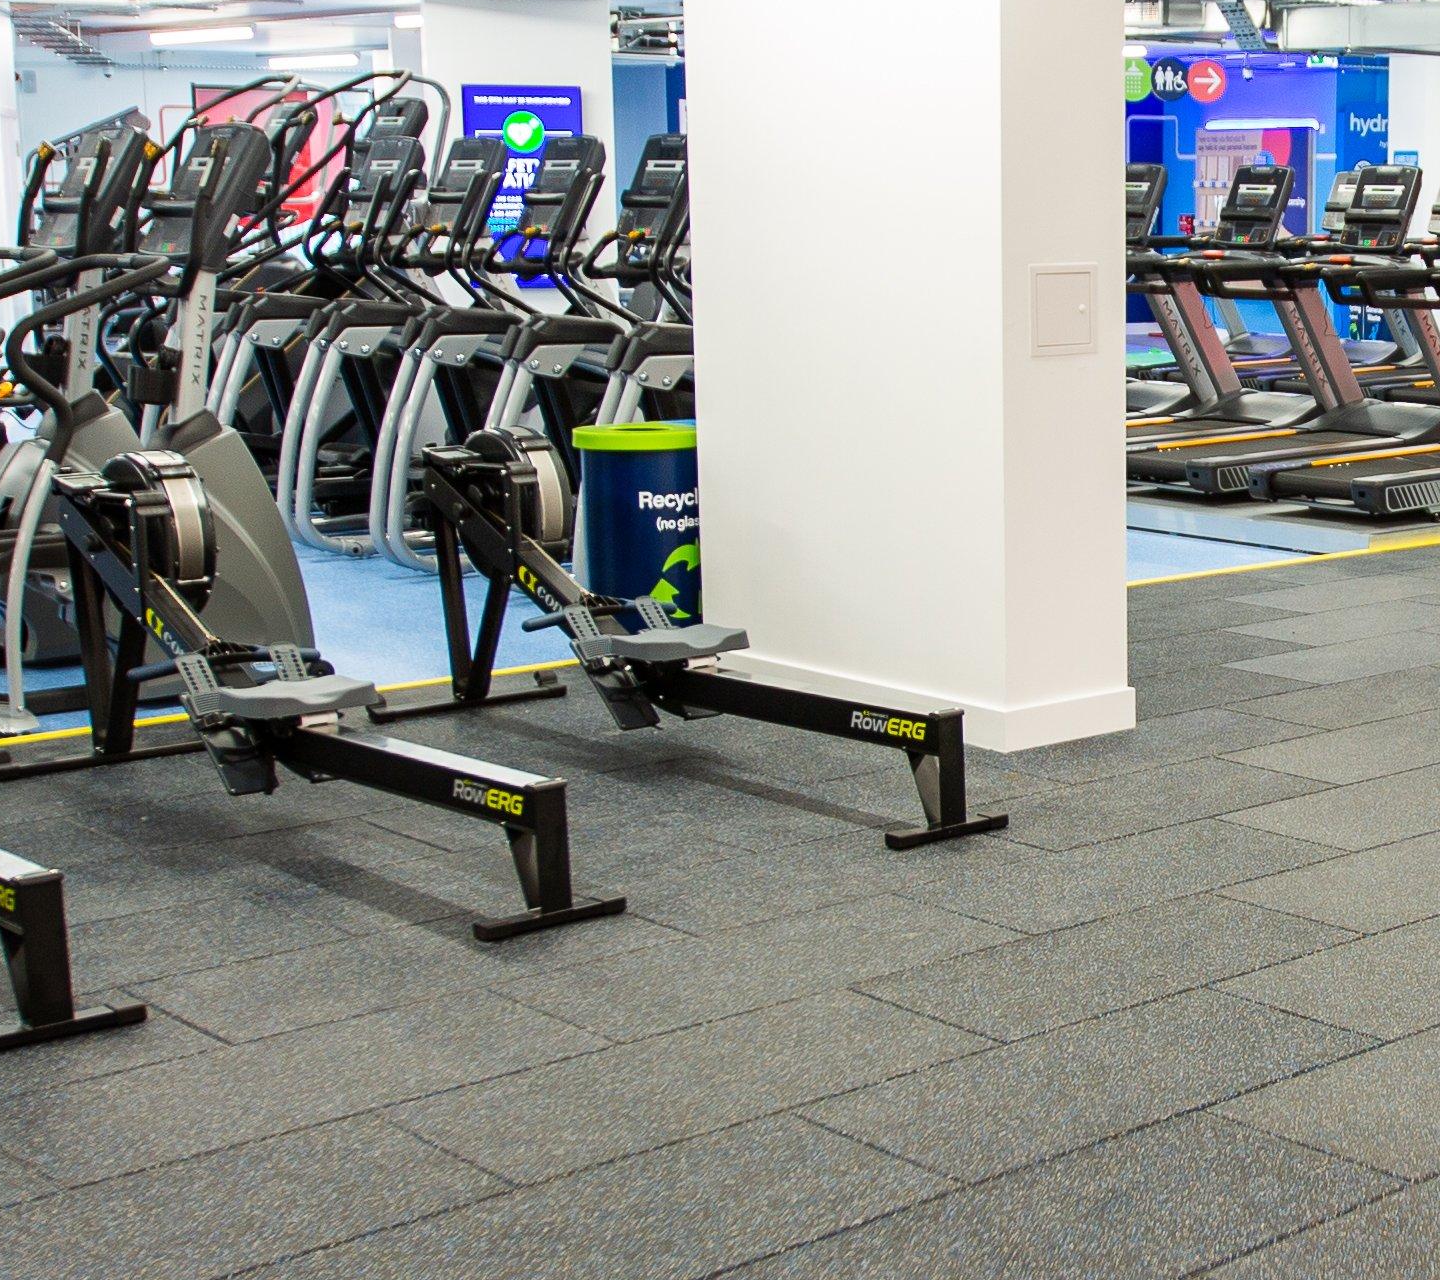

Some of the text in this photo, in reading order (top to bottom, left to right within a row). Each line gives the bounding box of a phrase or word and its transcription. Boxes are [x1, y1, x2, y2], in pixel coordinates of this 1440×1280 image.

[192, 295, 209, 384] MATRIX
[1162, 299, 1202, 377] MATRIX
[1290, 307, 1329, 388] MATRIX
[638, 487, 699, 512] Recycl
[656, 516, 677, 532] (no
[850, 710, 927, 740] RowERG
[453, 779, 524, 816] RowERG
